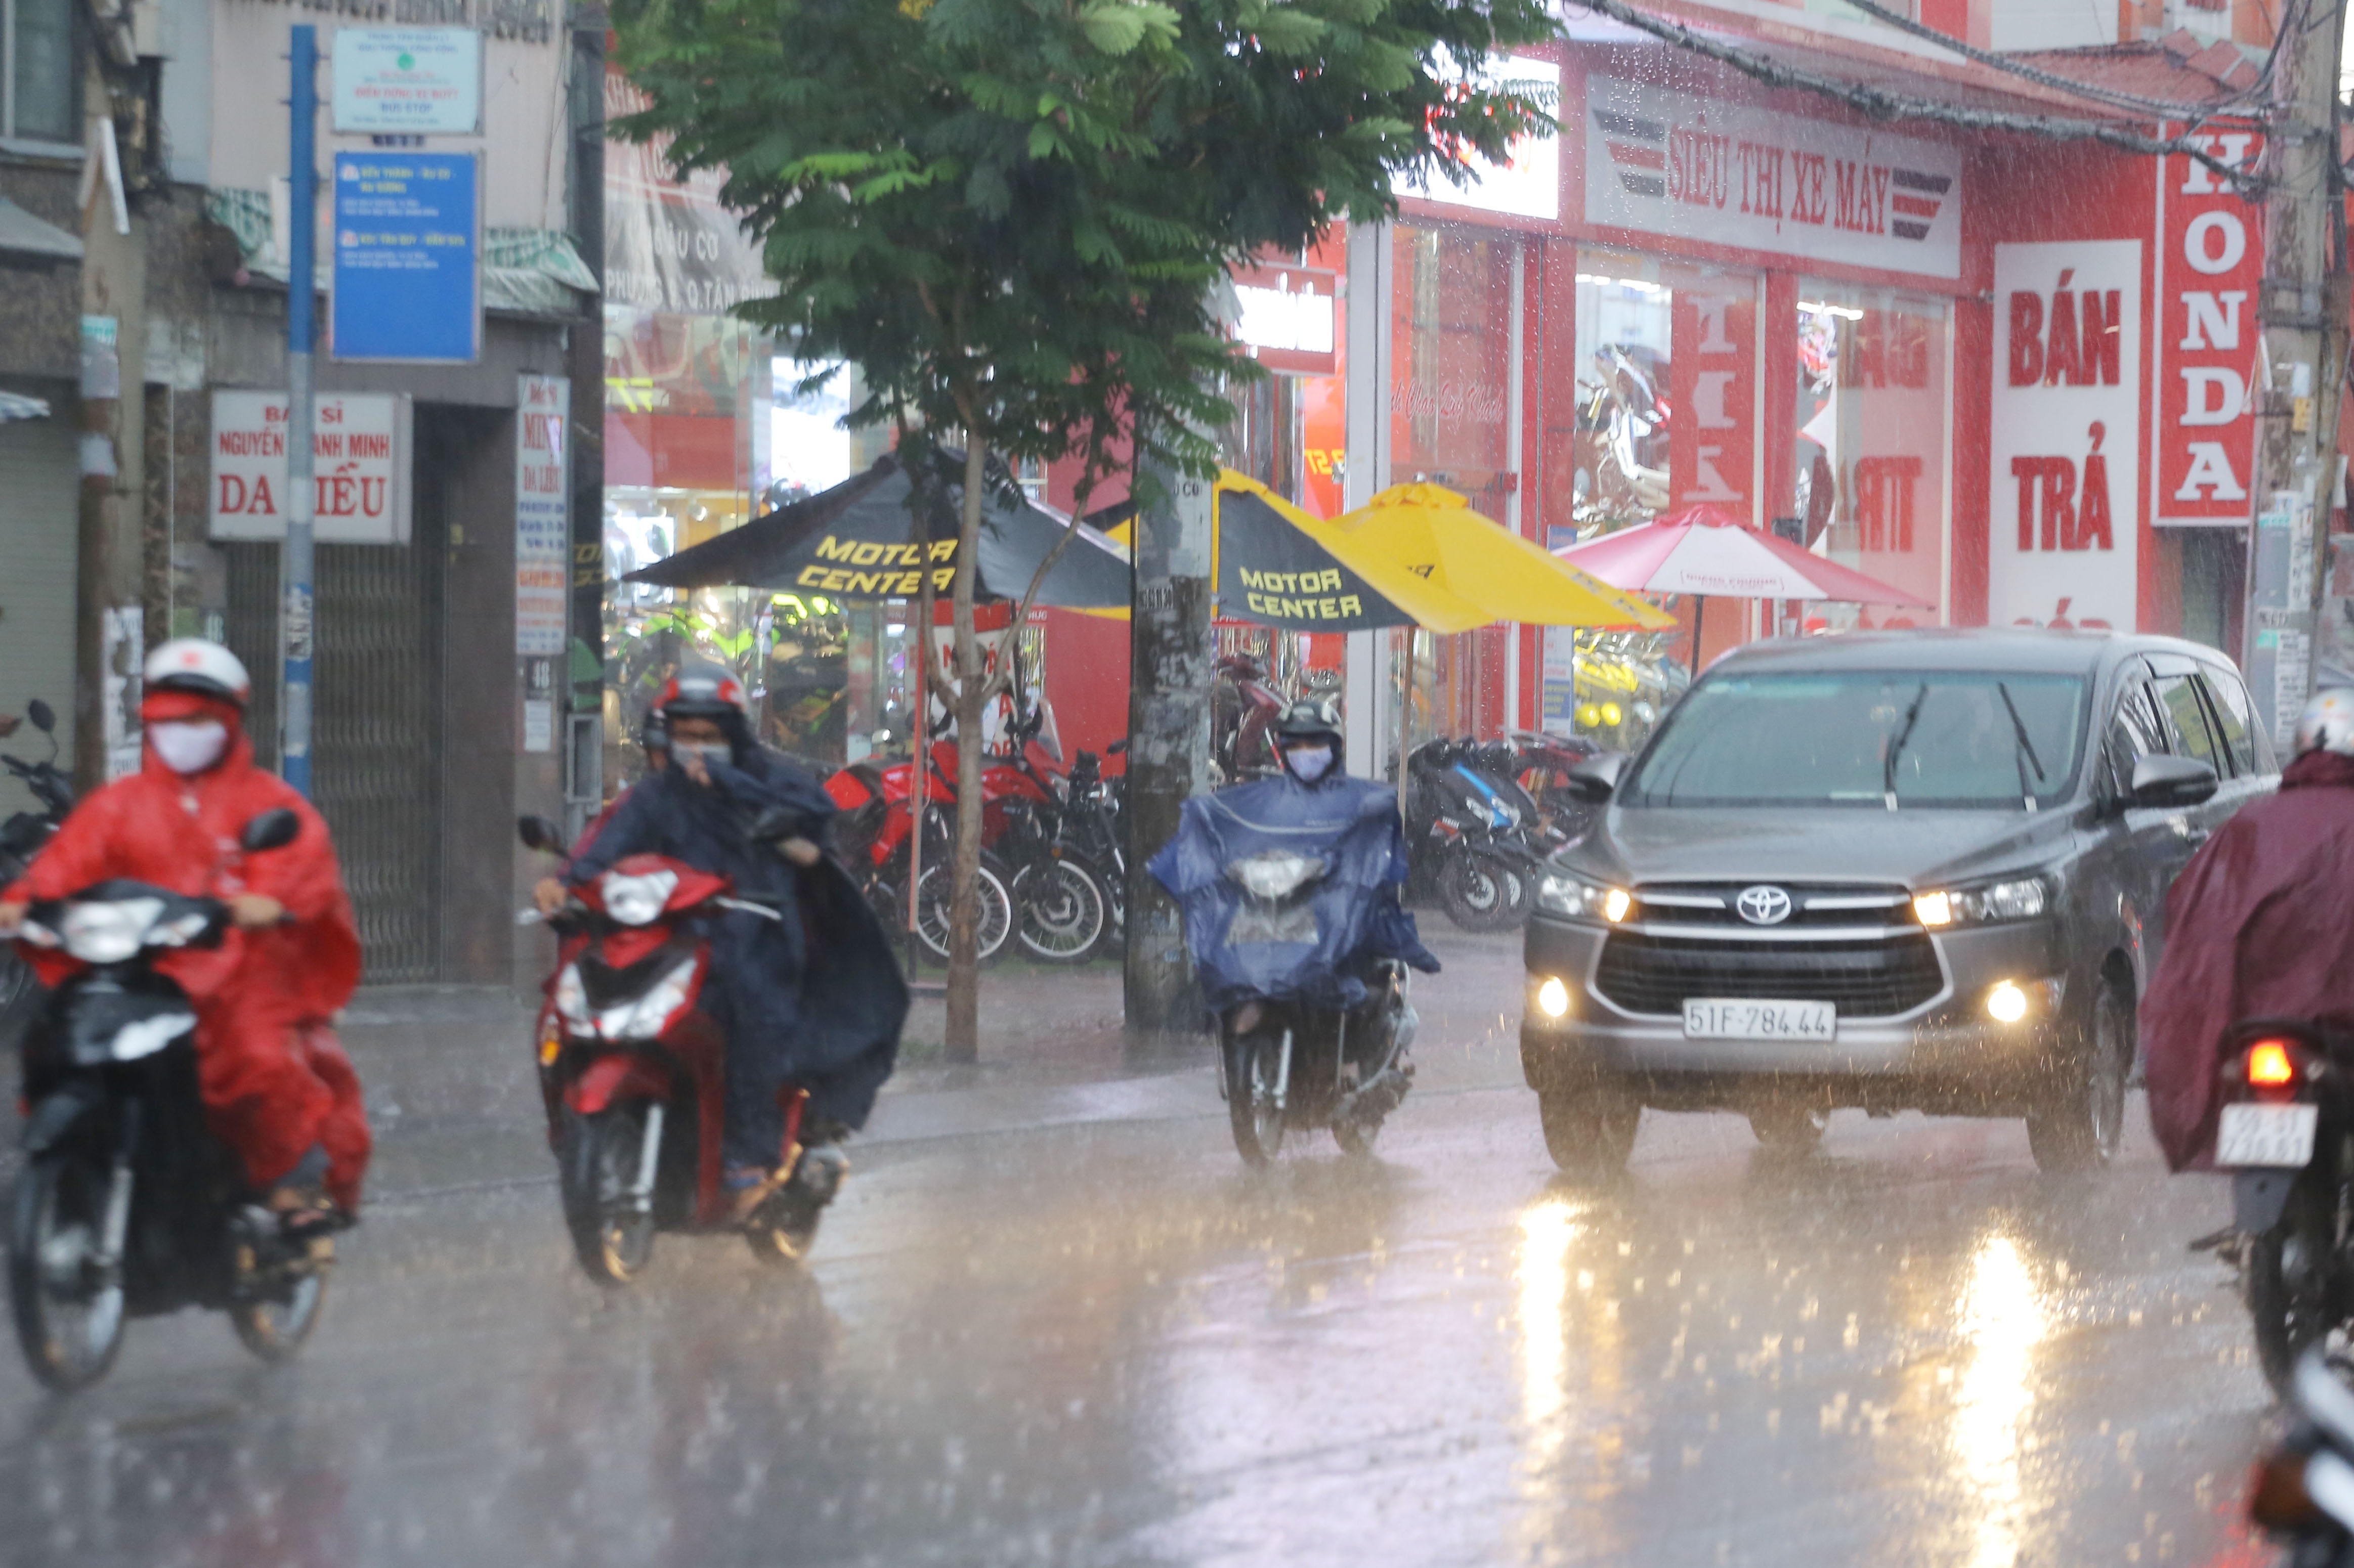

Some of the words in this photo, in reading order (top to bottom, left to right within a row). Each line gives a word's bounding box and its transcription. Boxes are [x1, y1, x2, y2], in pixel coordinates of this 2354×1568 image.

[1668, 113, 1729, 209] SIÊU
[1738, 140, 1784, 235] THỊ
[1790, 150, 1827, 226] XE
[1834, 138, 1891, 235] MÁY
[2008, 269, 2120, 386] BÁN
[349, 433, 390, 459] MINH
[219, 473, 277, 515] DA
[314, 461, 387, 517] IỄU
[2011, 421, 2114, 551] TRẢ
[797, 564, 956, 595] CENTER
[1239, 565, 1342, 594] MOTOR
[1247, 591, 1362, 620] CENTER
